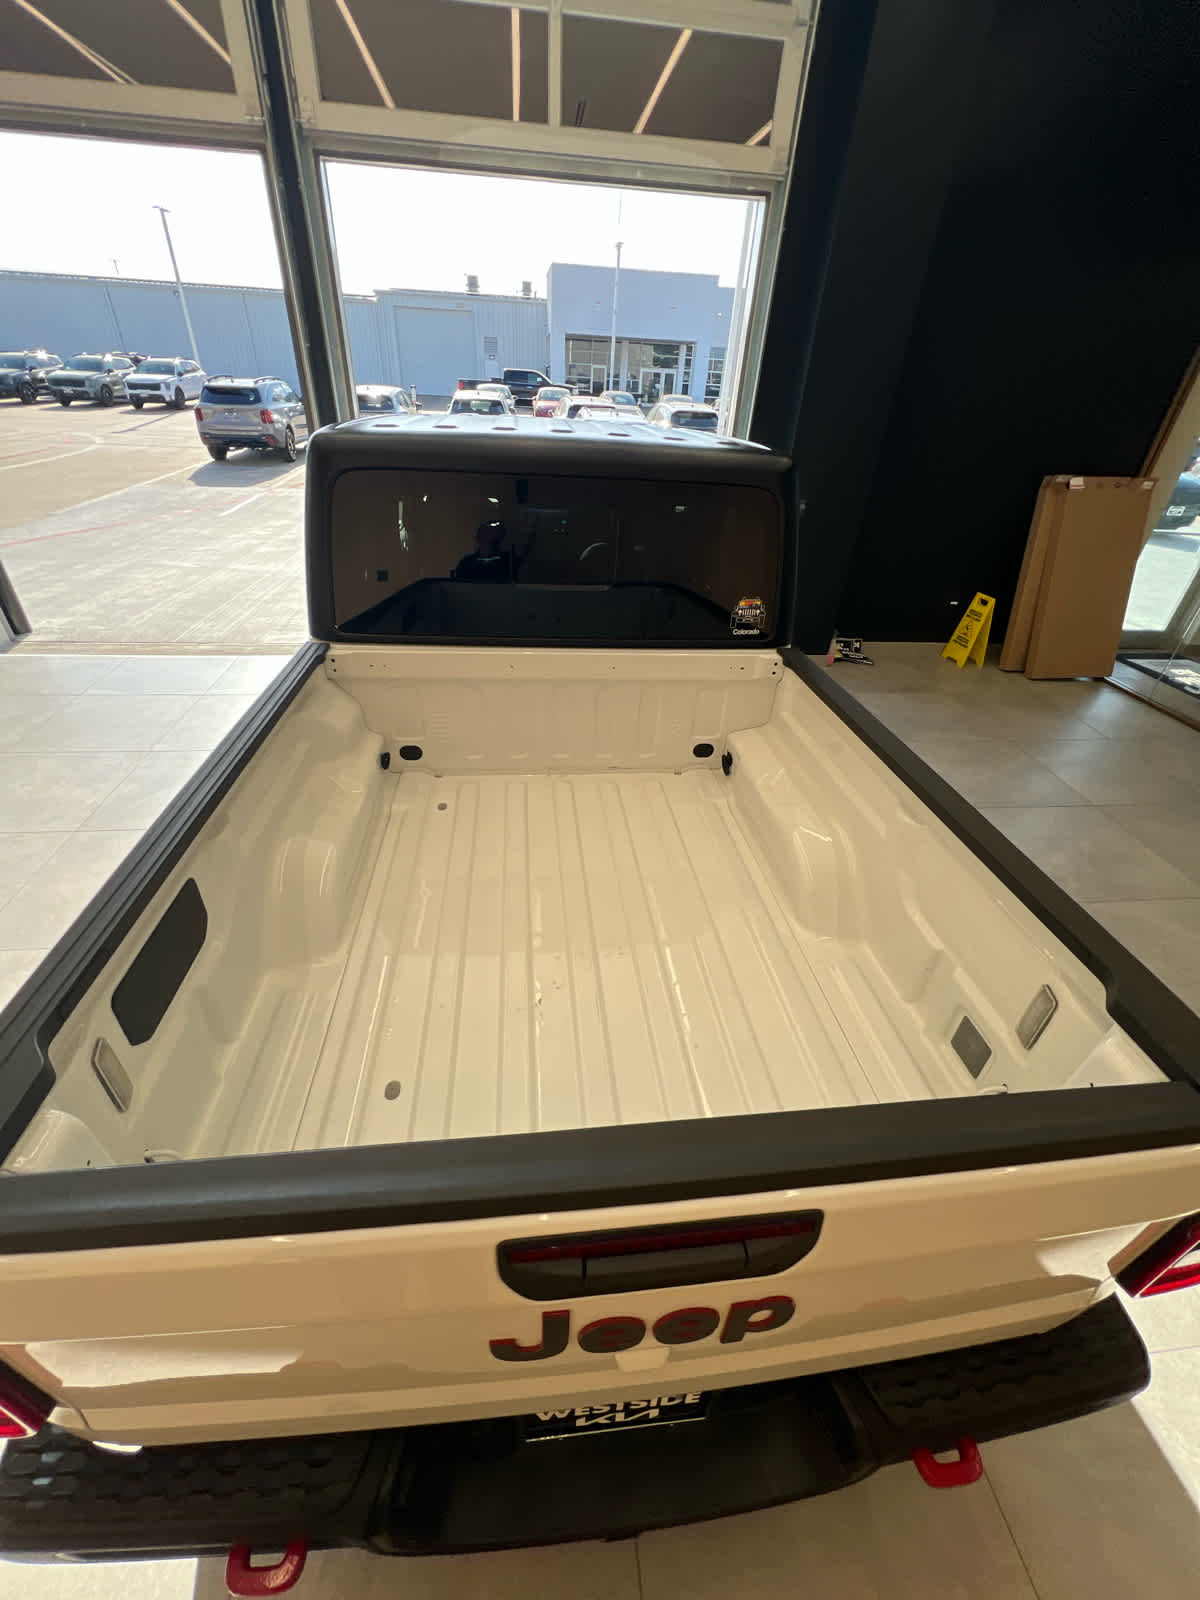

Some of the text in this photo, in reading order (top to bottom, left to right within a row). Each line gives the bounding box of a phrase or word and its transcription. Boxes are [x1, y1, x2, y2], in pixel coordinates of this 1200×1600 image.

[732, 627, 760, 636] Colorado
[489, 1295, 796, 1362] Jeep
[536, 1391, 702, 1422] WESTSIDE
